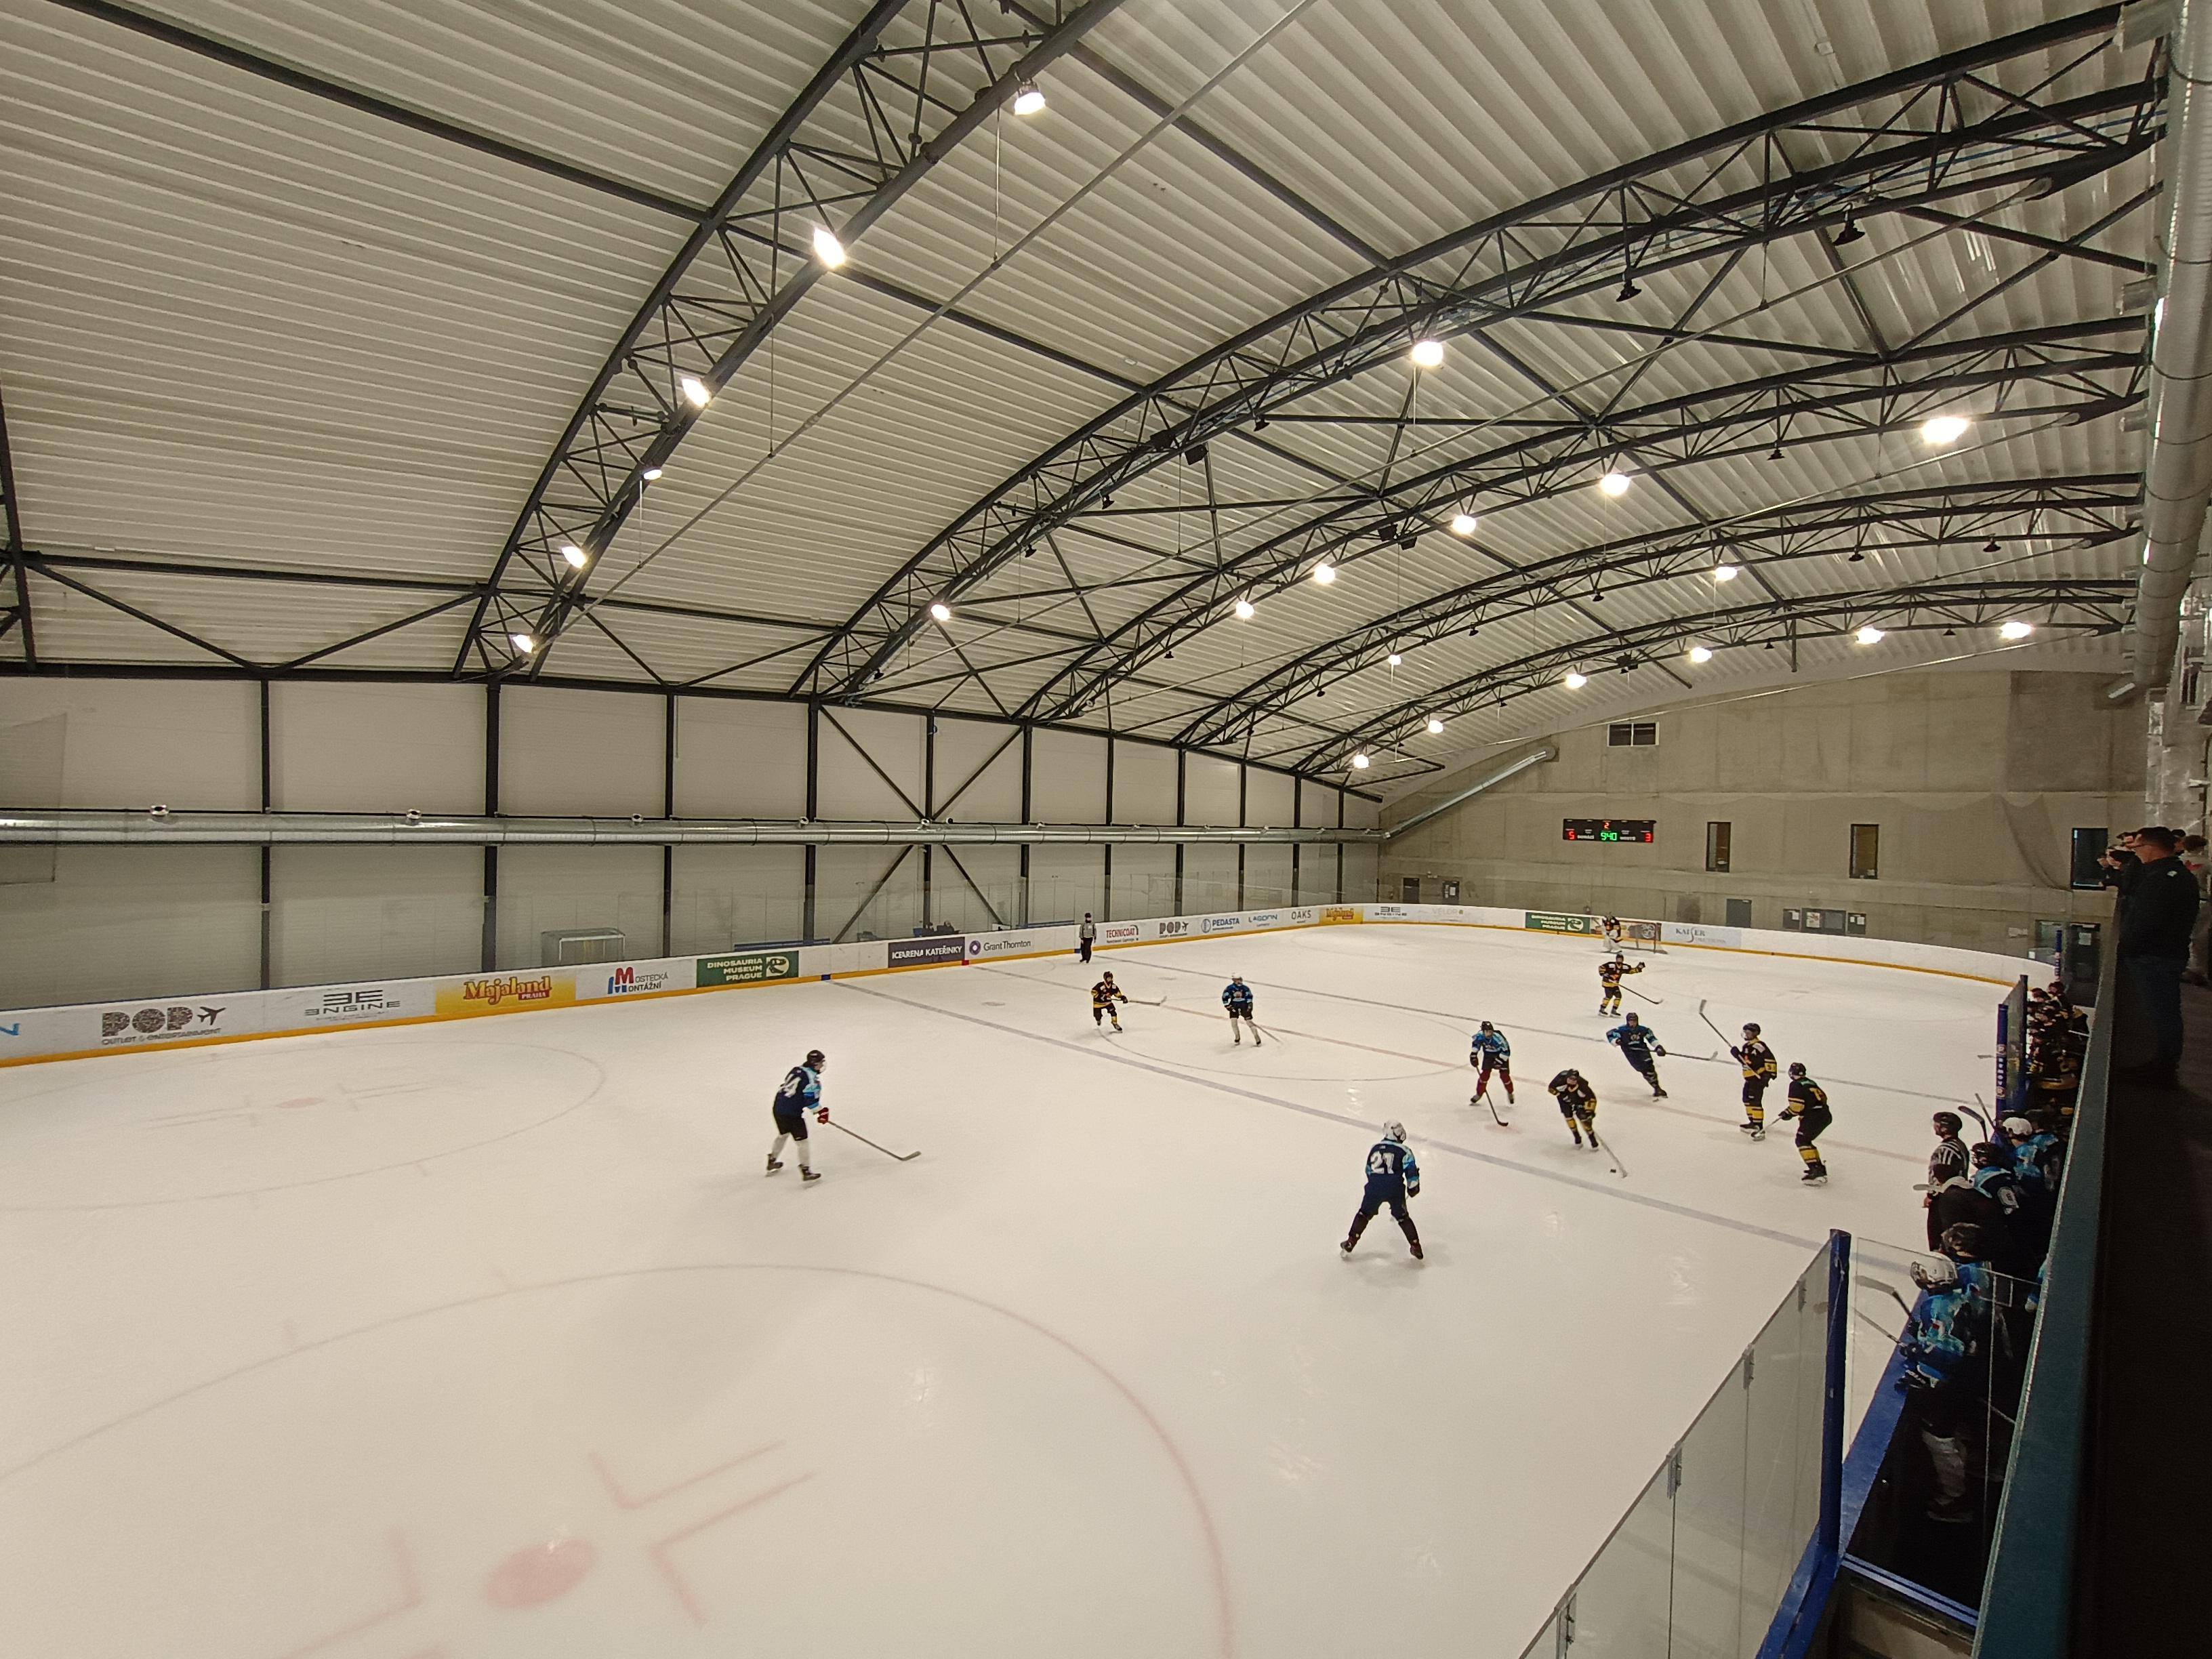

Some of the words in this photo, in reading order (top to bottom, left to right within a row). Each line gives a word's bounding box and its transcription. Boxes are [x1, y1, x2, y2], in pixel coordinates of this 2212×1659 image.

[1569, 831, 1575, 840] 5
[1645, 833, 1652, 842] 3
[1291, 910, 1311, 920] OAKS
[1212, 918, 1240, 926] PEDASTA
[1159, 921, 1181, 935] POP
[1106, 928, 1135, 939] TECHNICOAT
[983, 942, 1002, 951] Grant
[1002, 941, 1031, 949] Thornton
[707, 958, 762, 968] DINOSAURIA
[723, 965, 762, 975] MUSEUM
[726, 972, 762, 981] PRAGUE
[463, 975, 552, 1006] Majaland
[521, 991, 546, 1000] PRAHA
[102, 1006, 193, 1037] POP
[101, 1036, 136, 1045] OUTLET
[1370, 1151, 1395, 1174] 21
